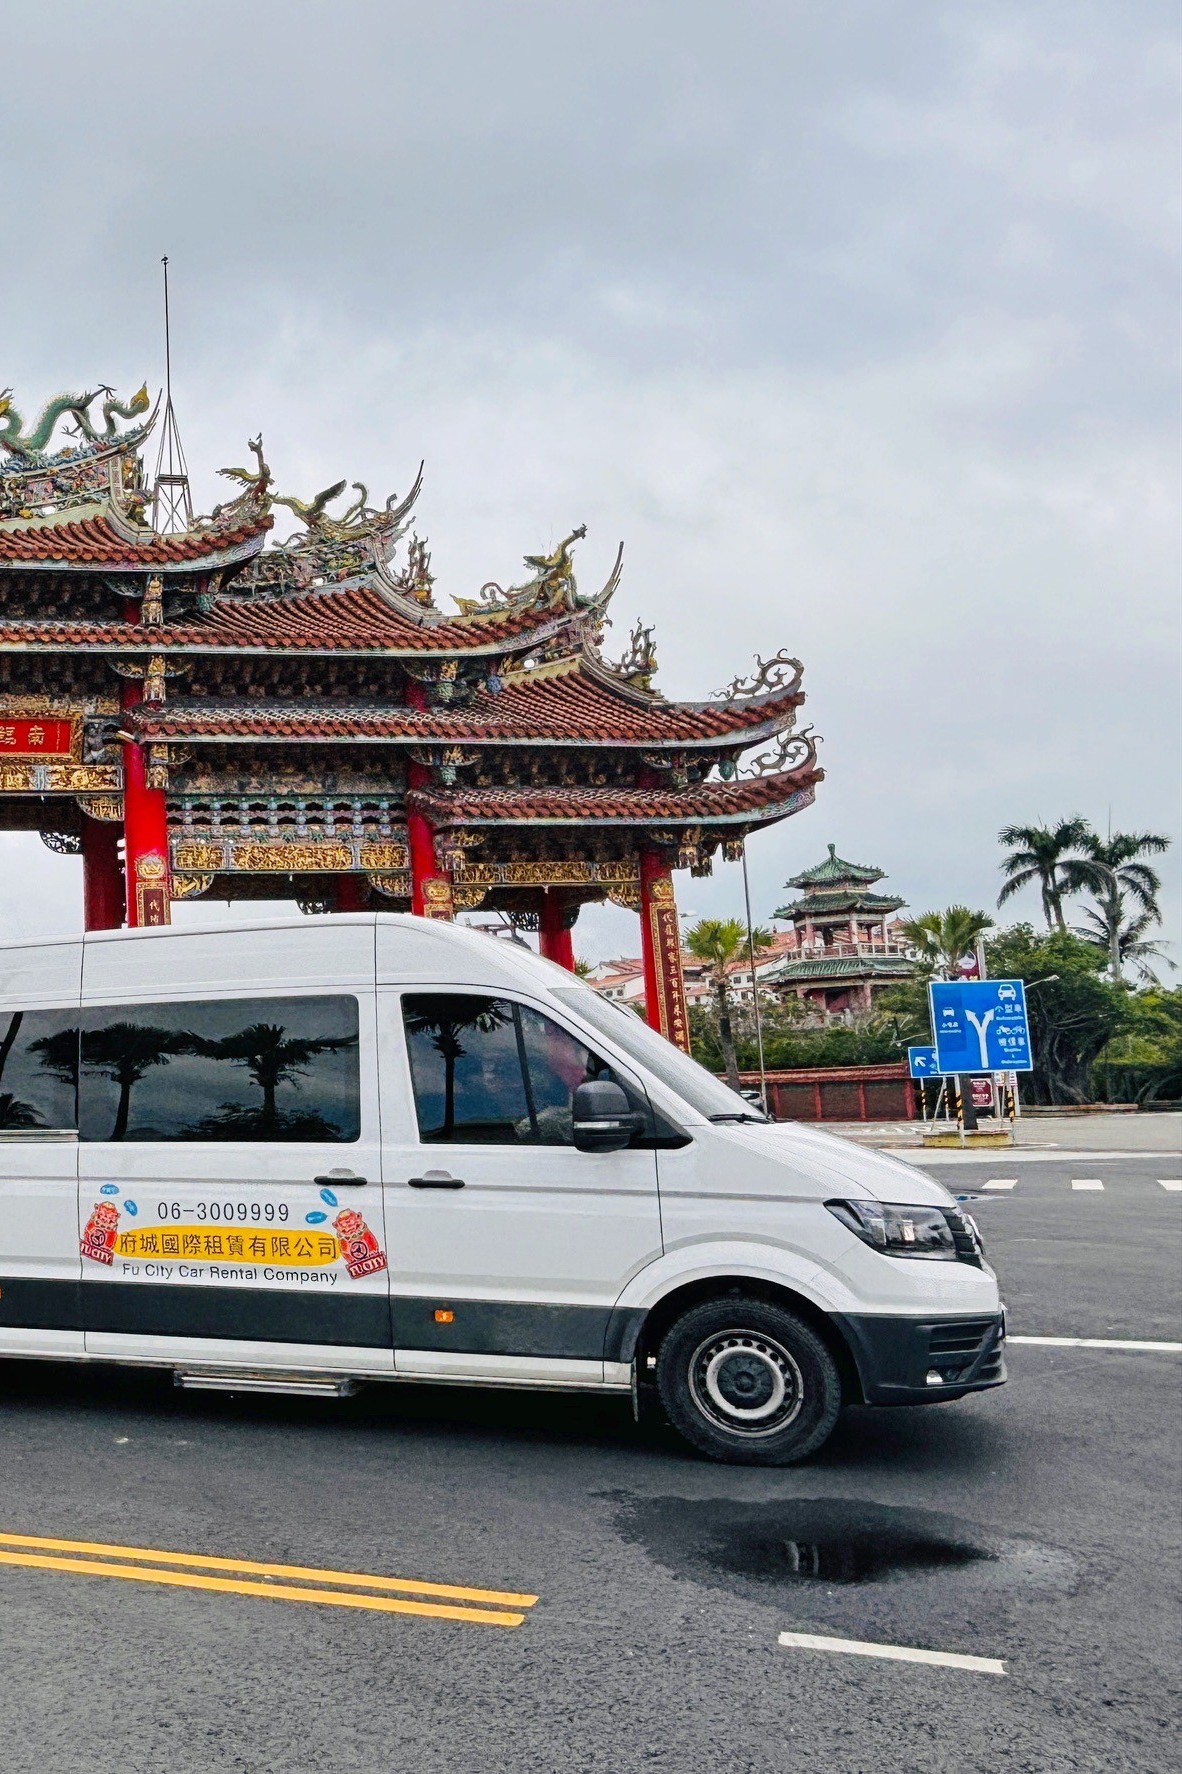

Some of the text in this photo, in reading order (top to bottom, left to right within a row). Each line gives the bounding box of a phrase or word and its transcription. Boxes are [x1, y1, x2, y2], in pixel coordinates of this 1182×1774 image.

[157, 1201, 289, 1222] 06-3009999
[120, 1233, 337, 1259] 府城國際租賃有限公司
[122, 1264, 338, 1284] Fu City Car Rental Company
